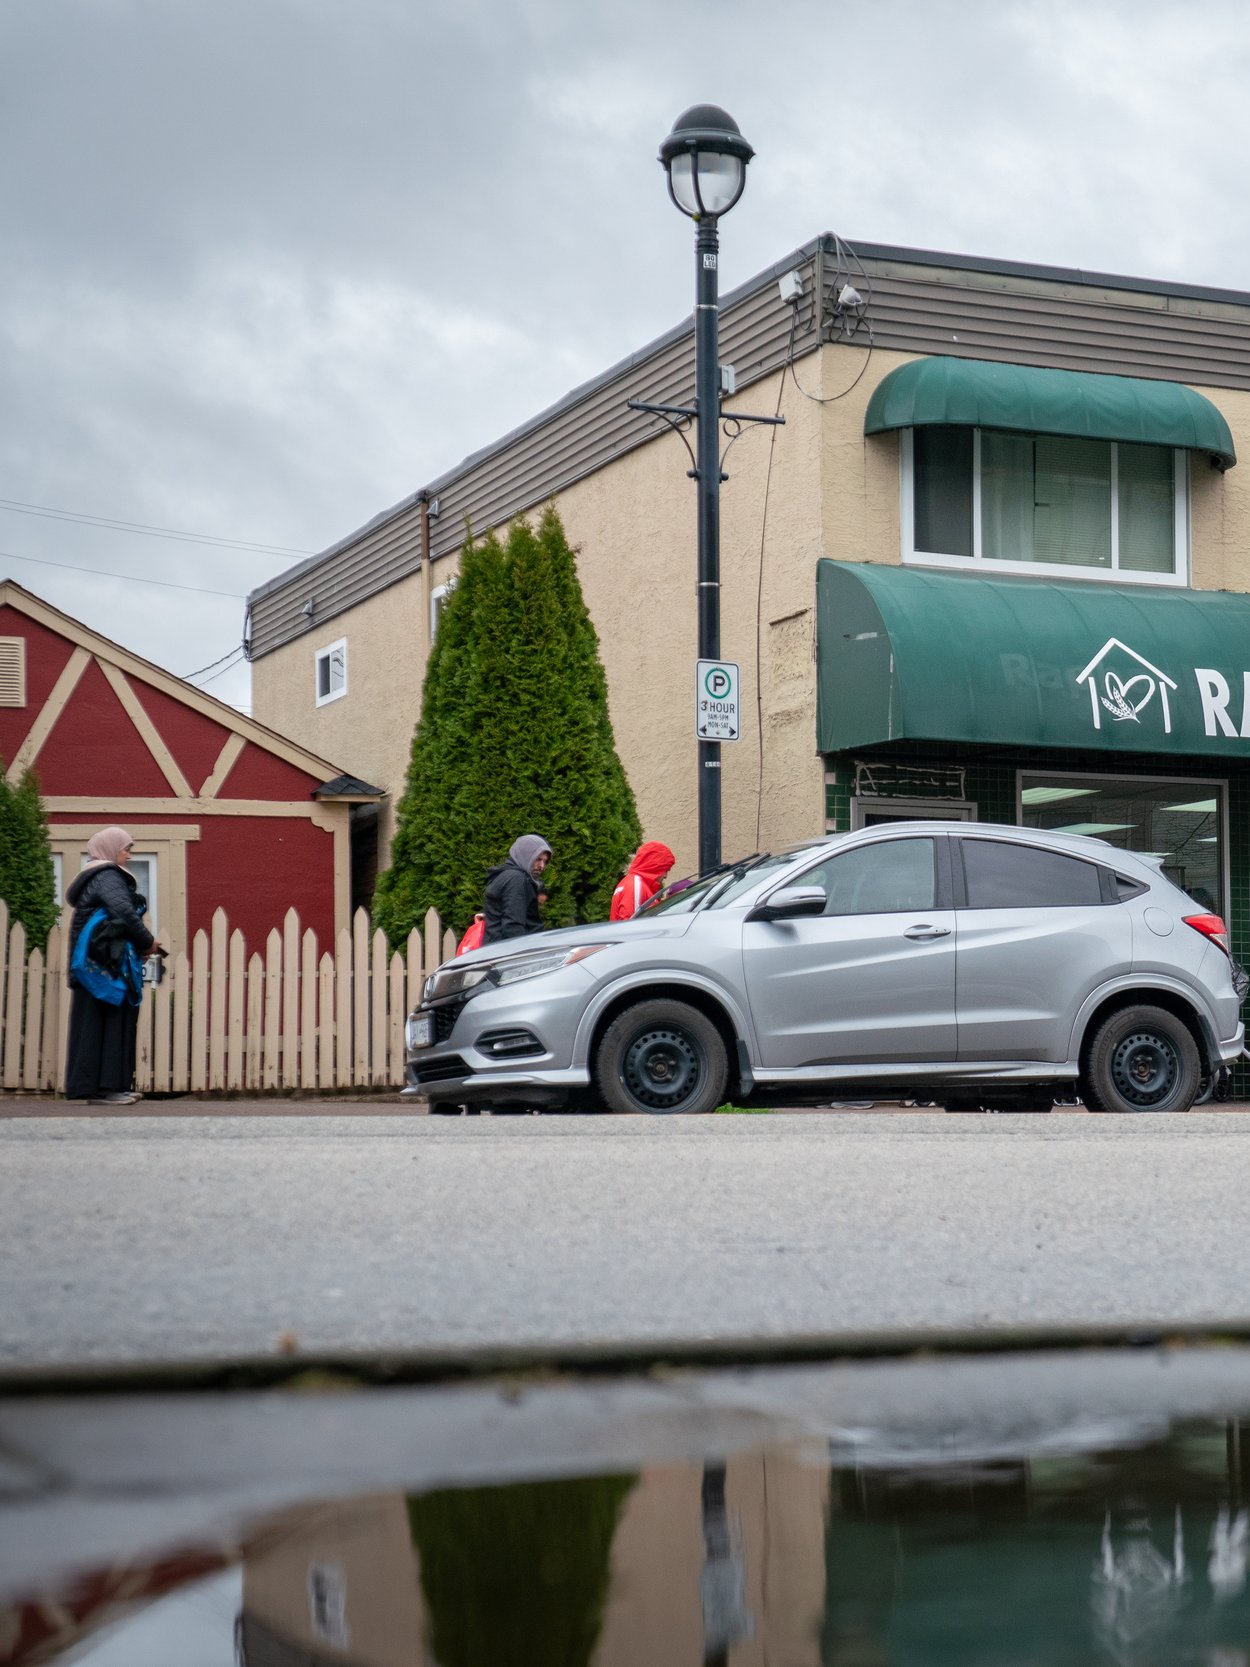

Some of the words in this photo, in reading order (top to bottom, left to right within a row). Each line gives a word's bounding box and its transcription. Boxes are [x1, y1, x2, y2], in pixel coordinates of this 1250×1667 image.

[714, 675, 725, 691] P
[701, 701, 708, 711] 3
[709, 702, 735, 713] HOUR
[707, 721, 729, 729] MON-SAT
